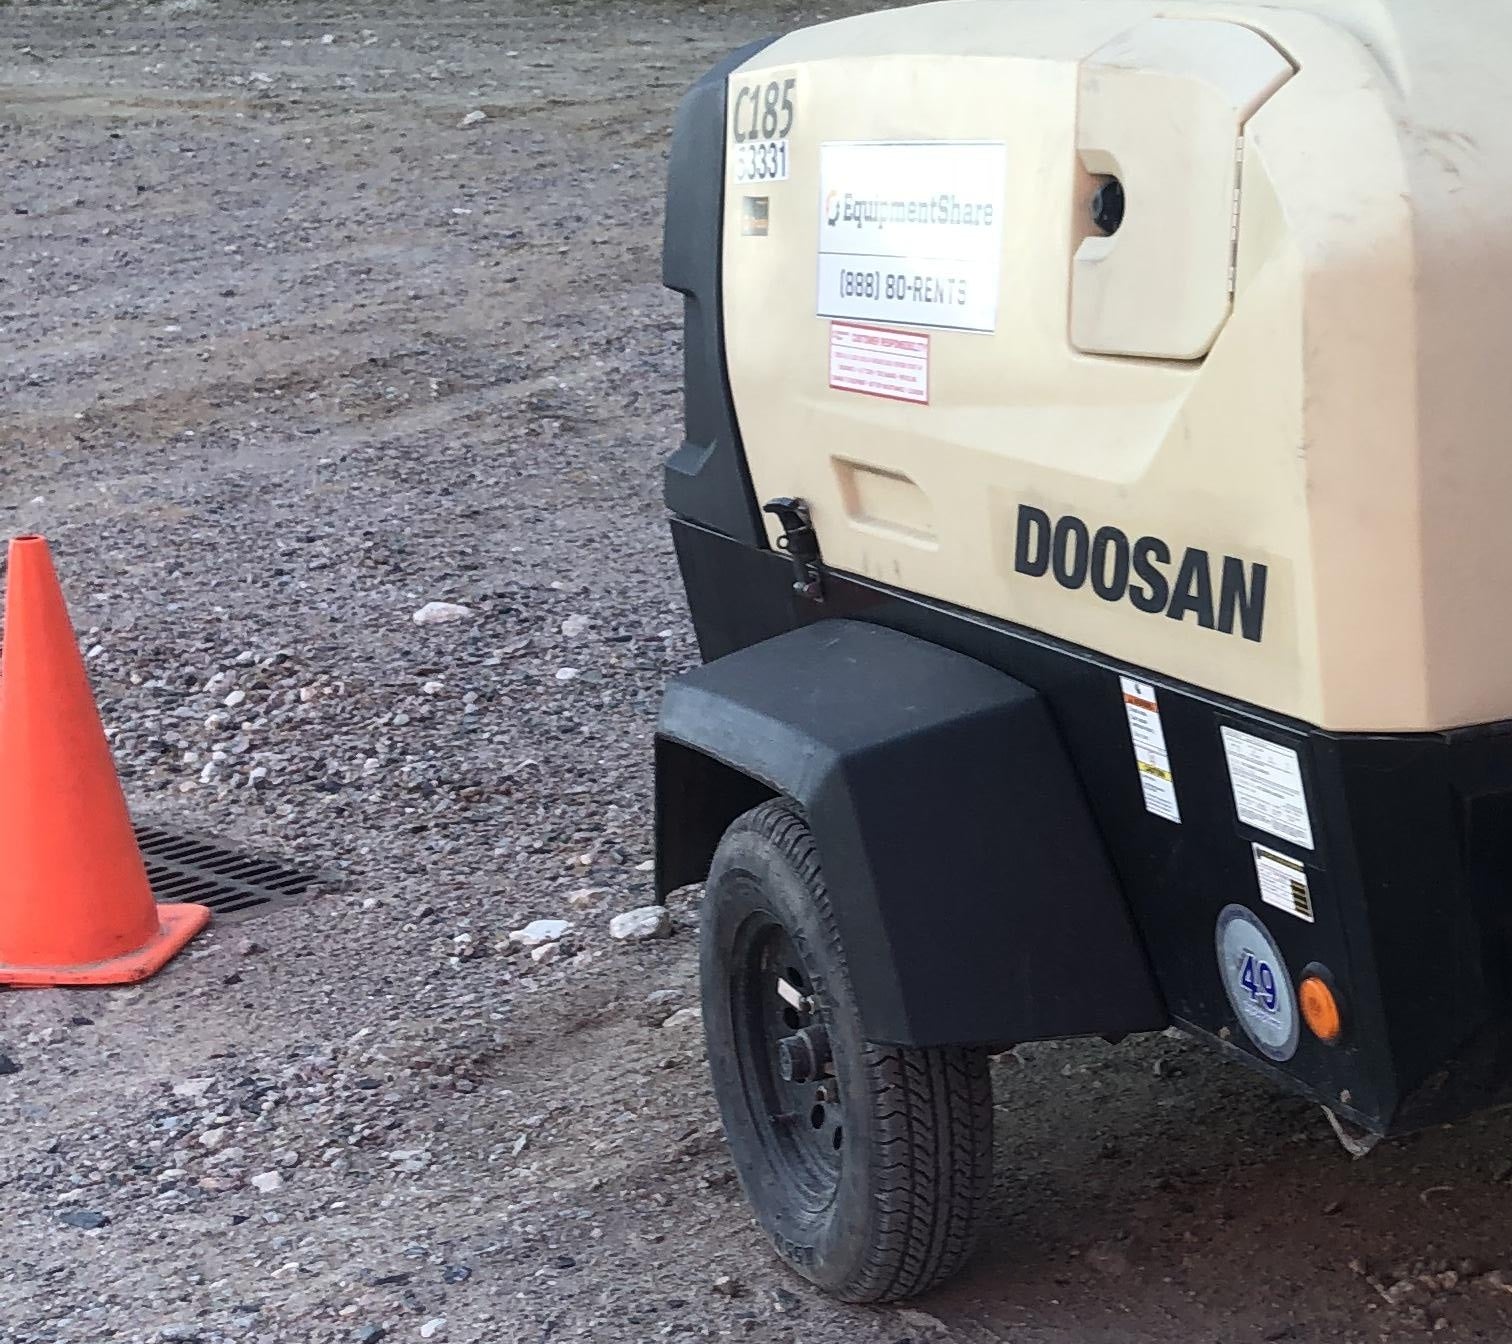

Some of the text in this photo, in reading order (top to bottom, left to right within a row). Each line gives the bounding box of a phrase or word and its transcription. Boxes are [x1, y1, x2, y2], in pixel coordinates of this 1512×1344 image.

[734, 78, 796, 143] C185
[843, 193, 993, 229] EquipmentShare
[840, 268, 967, 306] (888) 80-RENTS
[1014, 503, 1268, 643] DOOSAN
[1240, 953, 1278, 1012] 49
